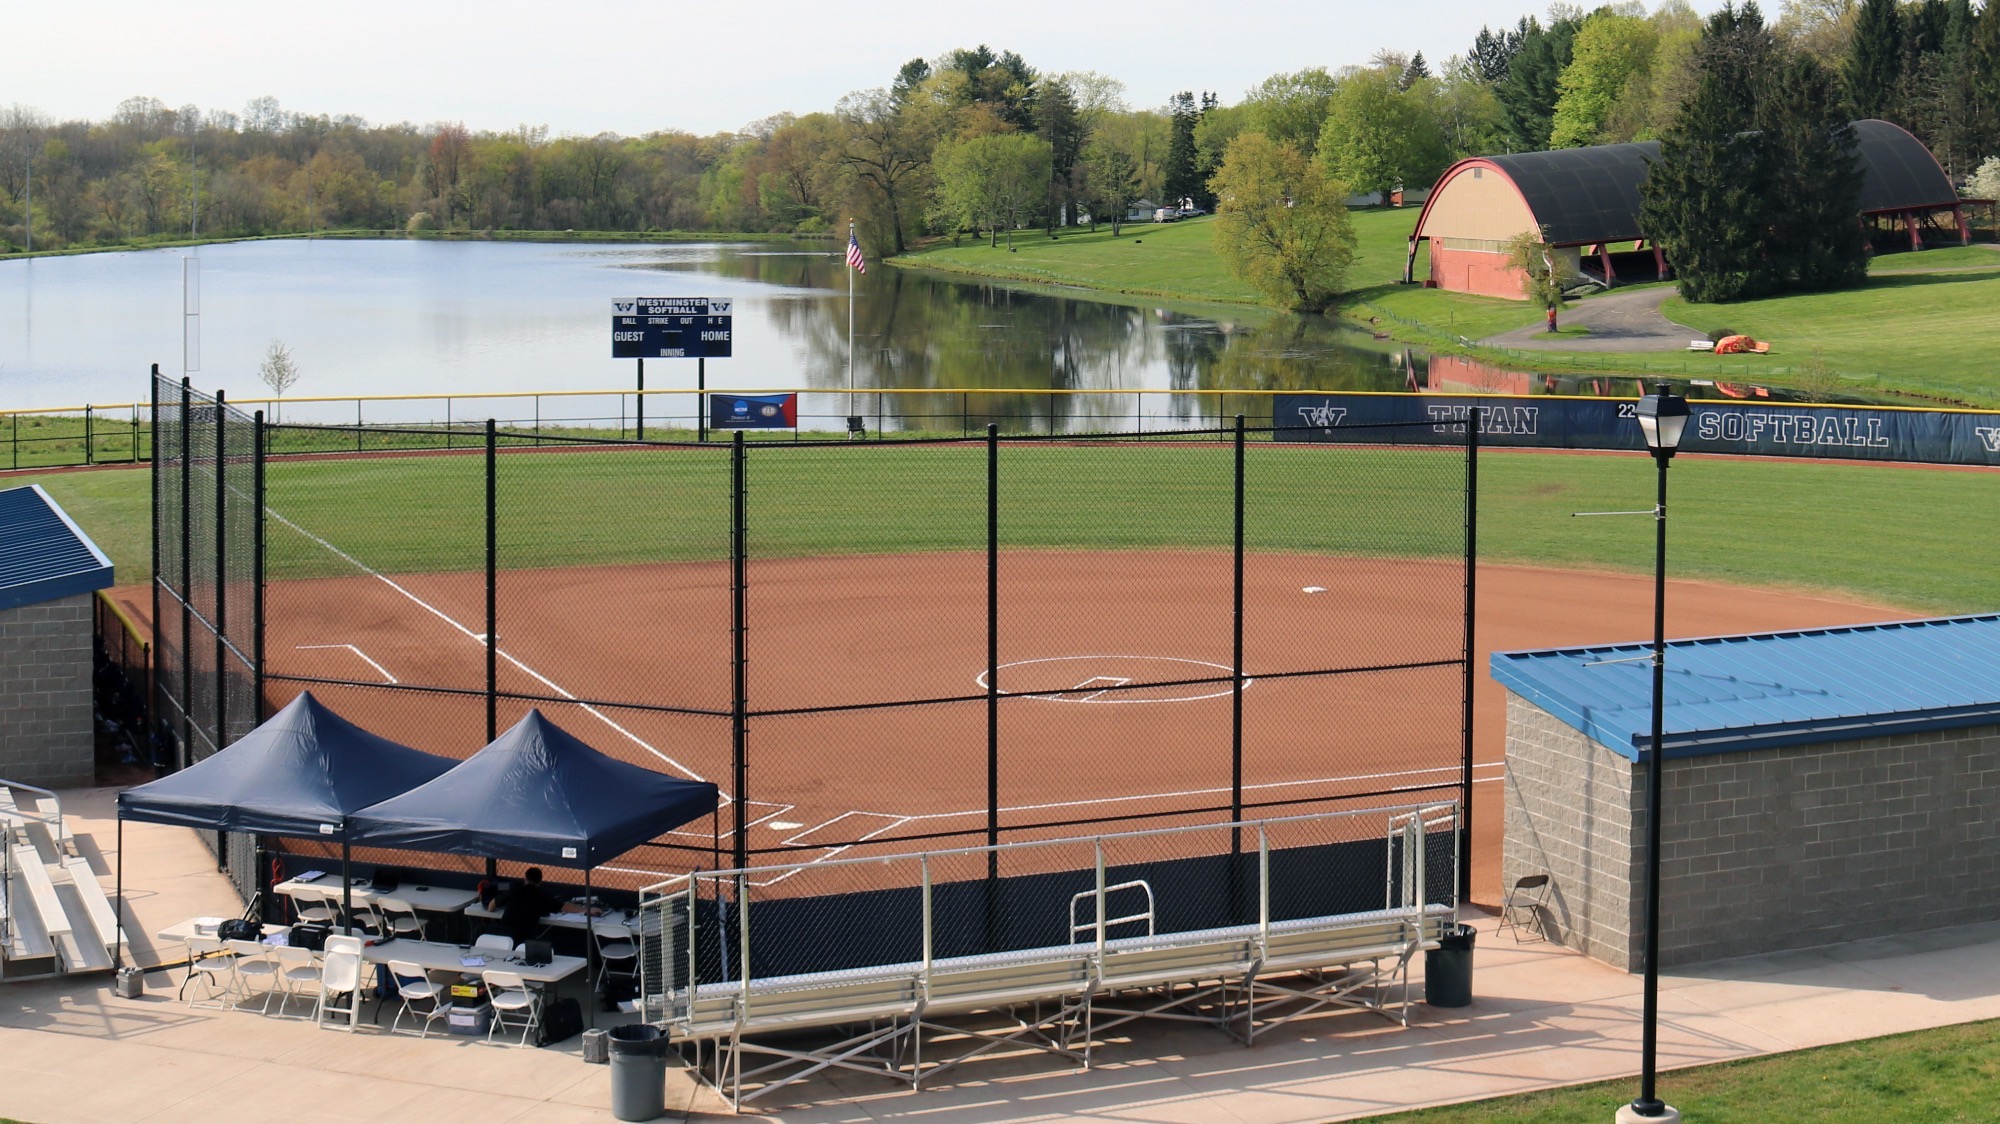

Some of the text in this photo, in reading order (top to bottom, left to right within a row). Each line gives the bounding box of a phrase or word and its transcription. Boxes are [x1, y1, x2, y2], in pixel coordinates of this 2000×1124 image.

[637, 299, 708, 307] WESTMINSTER
[648, 306, 698, 314] SOFTBALL
[622, 317, 723, 325] BALL STRIKE OUT H E
[614, 330, 730, 342] GUEST HOME
[660, 348, 685, 357] INNING
[1427, 405, 1539, 435] TITAN
[1698, 411, 1889, 448] SOFTBALL
